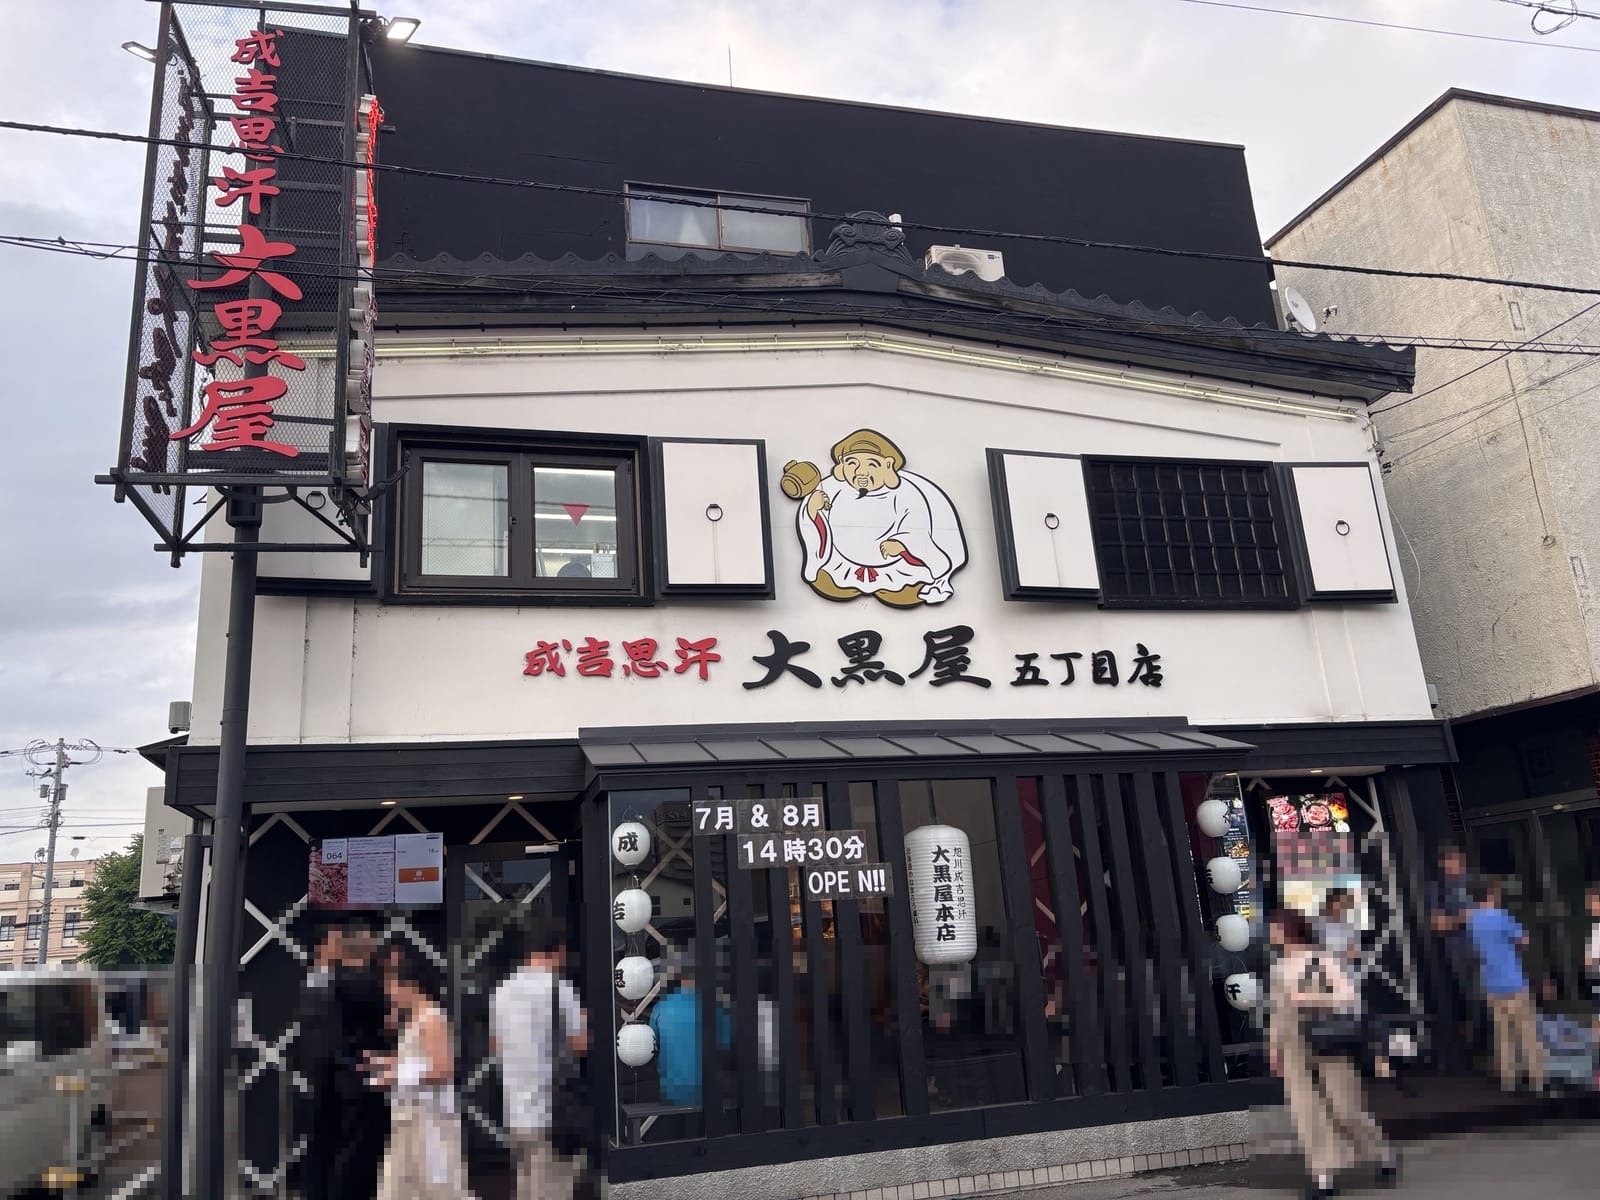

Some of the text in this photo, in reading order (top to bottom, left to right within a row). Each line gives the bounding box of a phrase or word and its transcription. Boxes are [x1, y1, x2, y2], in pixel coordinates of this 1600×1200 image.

[169, 30, 305, 458] 成吉思汗 大黒屋
[523, 624, 1164, 689] 成吉思汗 大黒屋 五丁目店
[695, 803, 820, 830] 7月 & 8月
[326, 851, 343, 860] 064
[618, 832, 639, 852] 成
[742, 835, 865, 864] 14時30分
[931, 844, 956, 942] 大黒屋本店
[953, 847, 967, 920] 旭川成吉思汗
